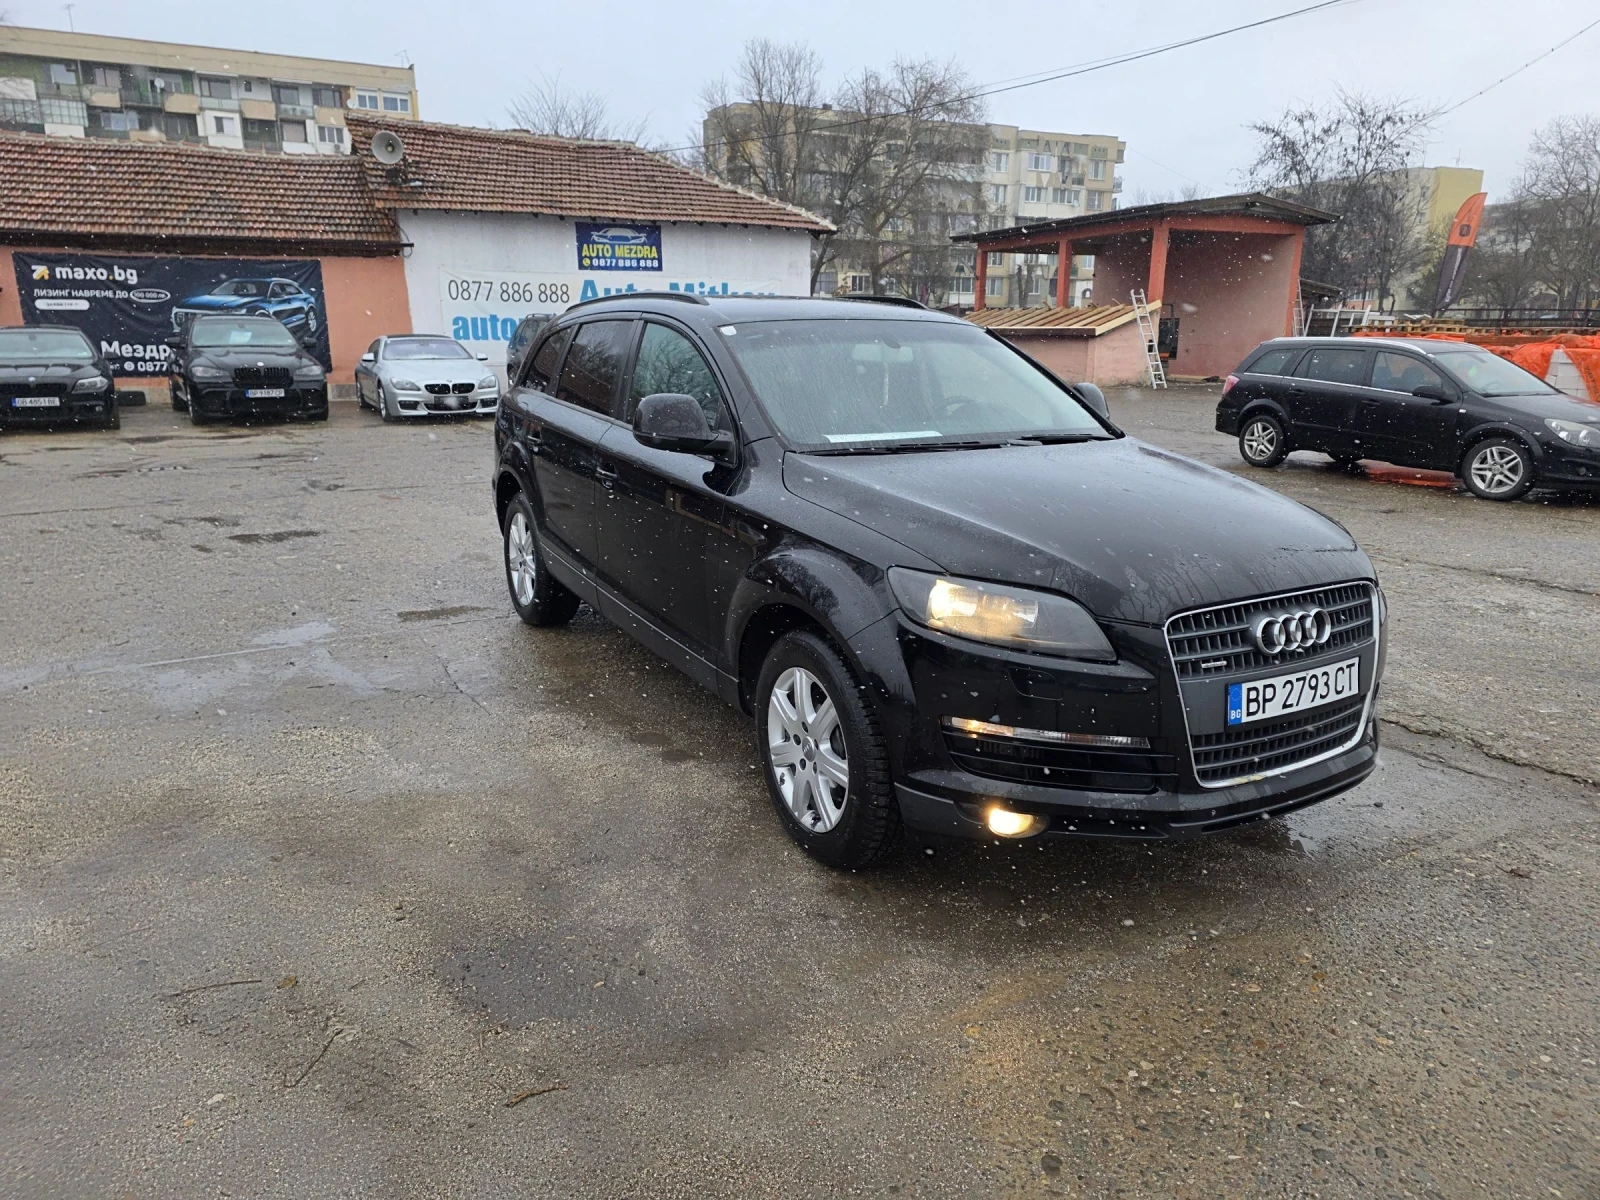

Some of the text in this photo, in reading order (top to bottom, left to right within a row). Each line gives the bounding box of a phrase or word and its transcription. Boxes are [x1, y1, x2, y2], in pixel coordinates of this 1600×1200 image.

[582, 244, 658, 258] AUTO MEZDRA
[592, 258, 616, 267] 0877
[639, 259, 659, 268] 888
[55, 265, 138, 284] maxo.bg
[33, 288, 70, 298] ЛИЗИНГ
[71, 289, 114, 298] НАВРЕМЕ
[115, 289, 129, 299] ДО
[448, 279, 493, 301] 0877
[500, 281, 533, 302] 886
[538, 283, 570, 303] 888
[452, 314, 523, 341] auto
[100, 340, 171, 360] Мездр
[137, 361, 168, 372] 0877
[1230, 663, 1356, 719] BG BP 2793 CT
